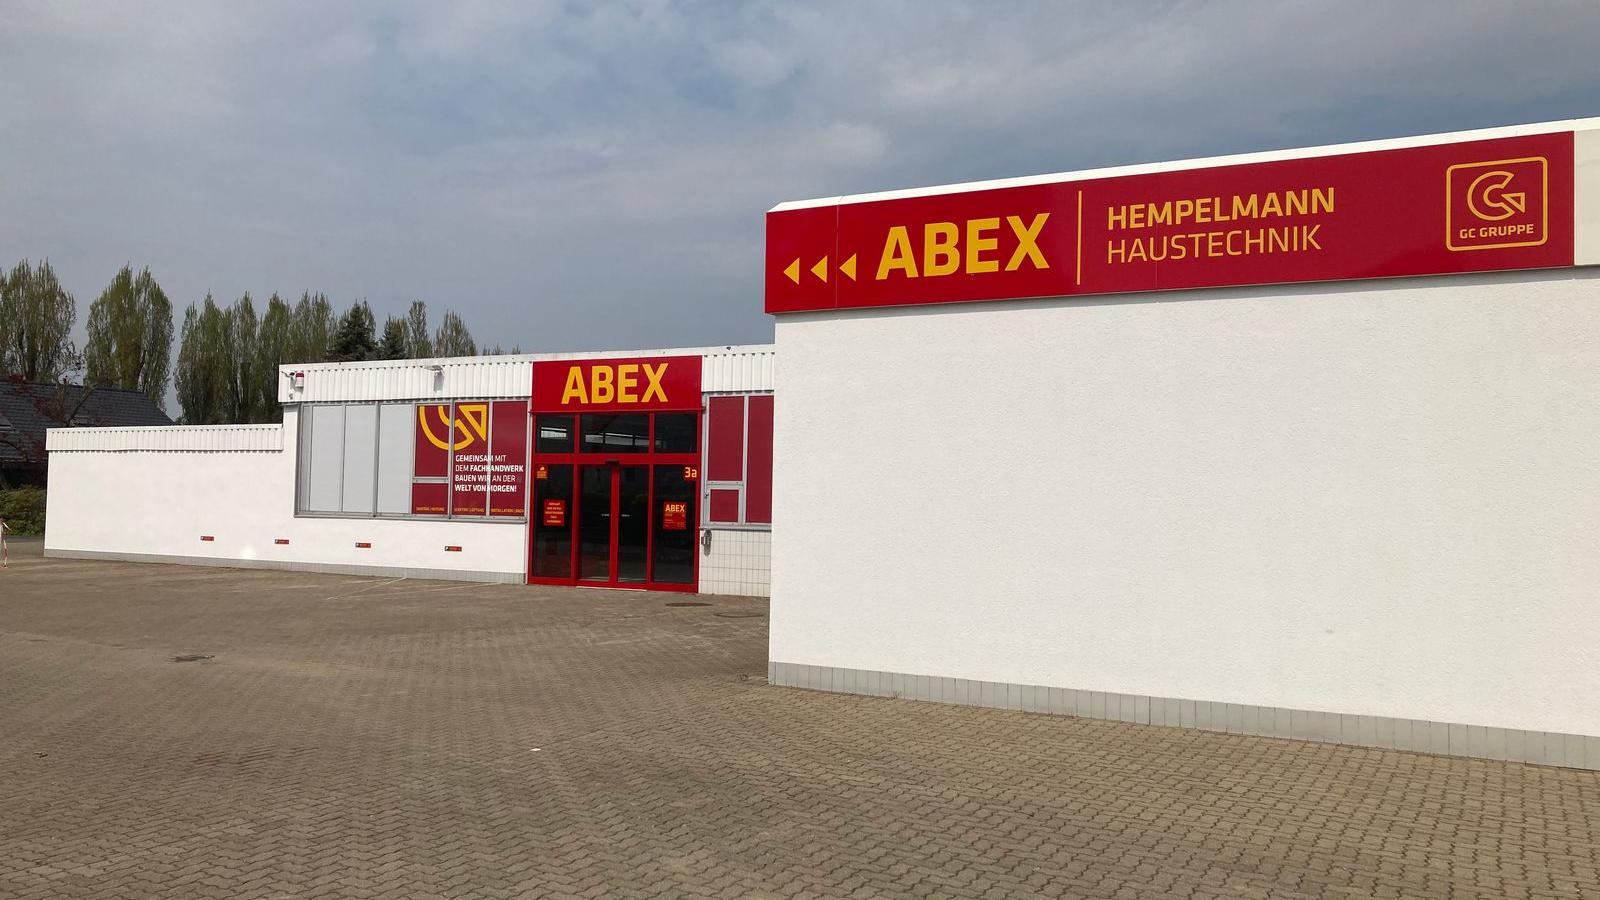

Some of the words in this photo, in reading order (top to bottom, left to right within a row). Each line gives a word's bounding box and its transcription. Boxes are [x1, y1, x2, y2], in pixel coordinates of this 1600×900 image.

[1107, 187, 1335, 230] HEMPELMANN
[1460, 229, 1476, 239] GC
[1480, 224, 1534, 237] GRUPPE
[876, 213, 1050, 281] ABEX
[1107, 224, 1322, 264] HAUSTECHNIK
[561, 363, 669, 404] ABEX
[455, 474, 477, 482] BAUEN
[477, 474, 491, 482] WIR
[684, 466, 698, 478] 3a
[455, 484, 472, 492] WELT
[473, 484, 486, 492] VON
[664, 504, 685, 513] ABEX
